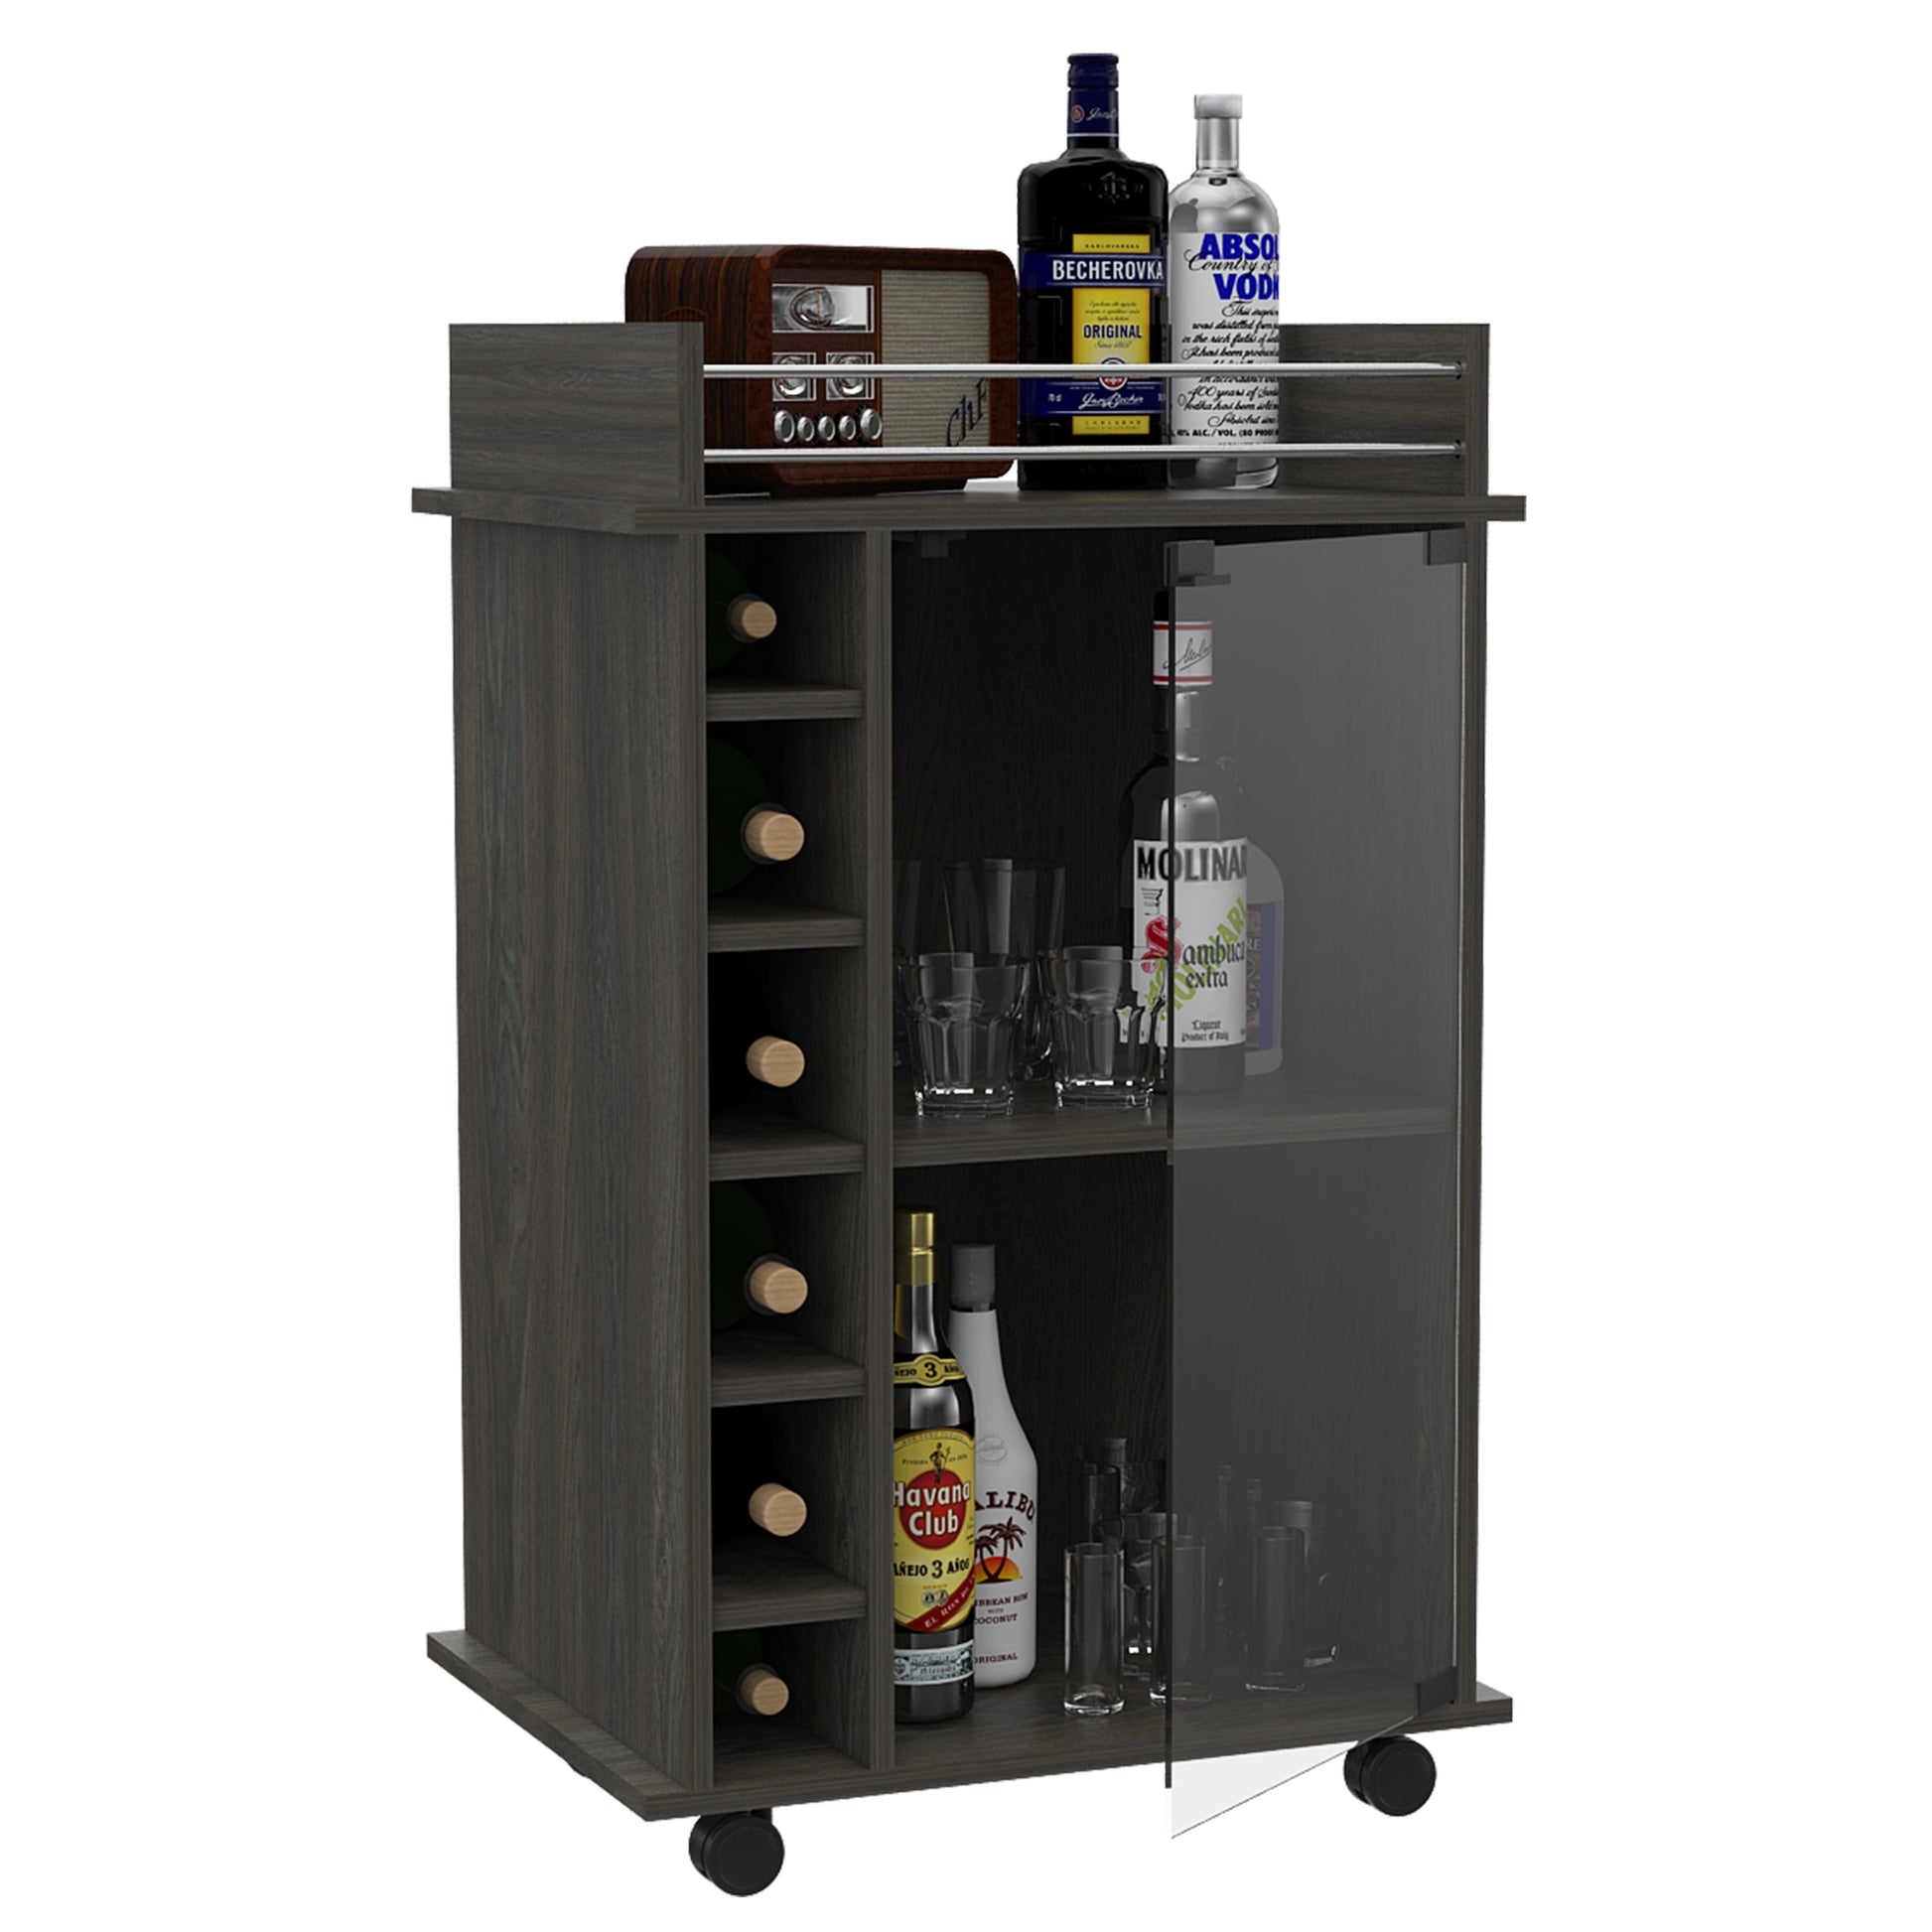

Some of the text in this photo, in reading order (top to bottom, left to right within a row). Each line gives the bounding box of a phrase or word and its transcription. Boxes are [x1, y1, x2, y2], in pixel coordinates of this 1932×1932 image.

[1052, 259, 1164, 280] BECHEROVKA
[1183, 249, 1257, 275] Country
[1083, 324, 1142, 339] ORIGINAL
[1185, 967, 1229, 988] extra
[923, 1362, 937, 1378] 3
[894, 1482, 970, 1507] Havana
[908, 1509, 959, 1537] Club
[931, 1560, 943, 1579] 3
